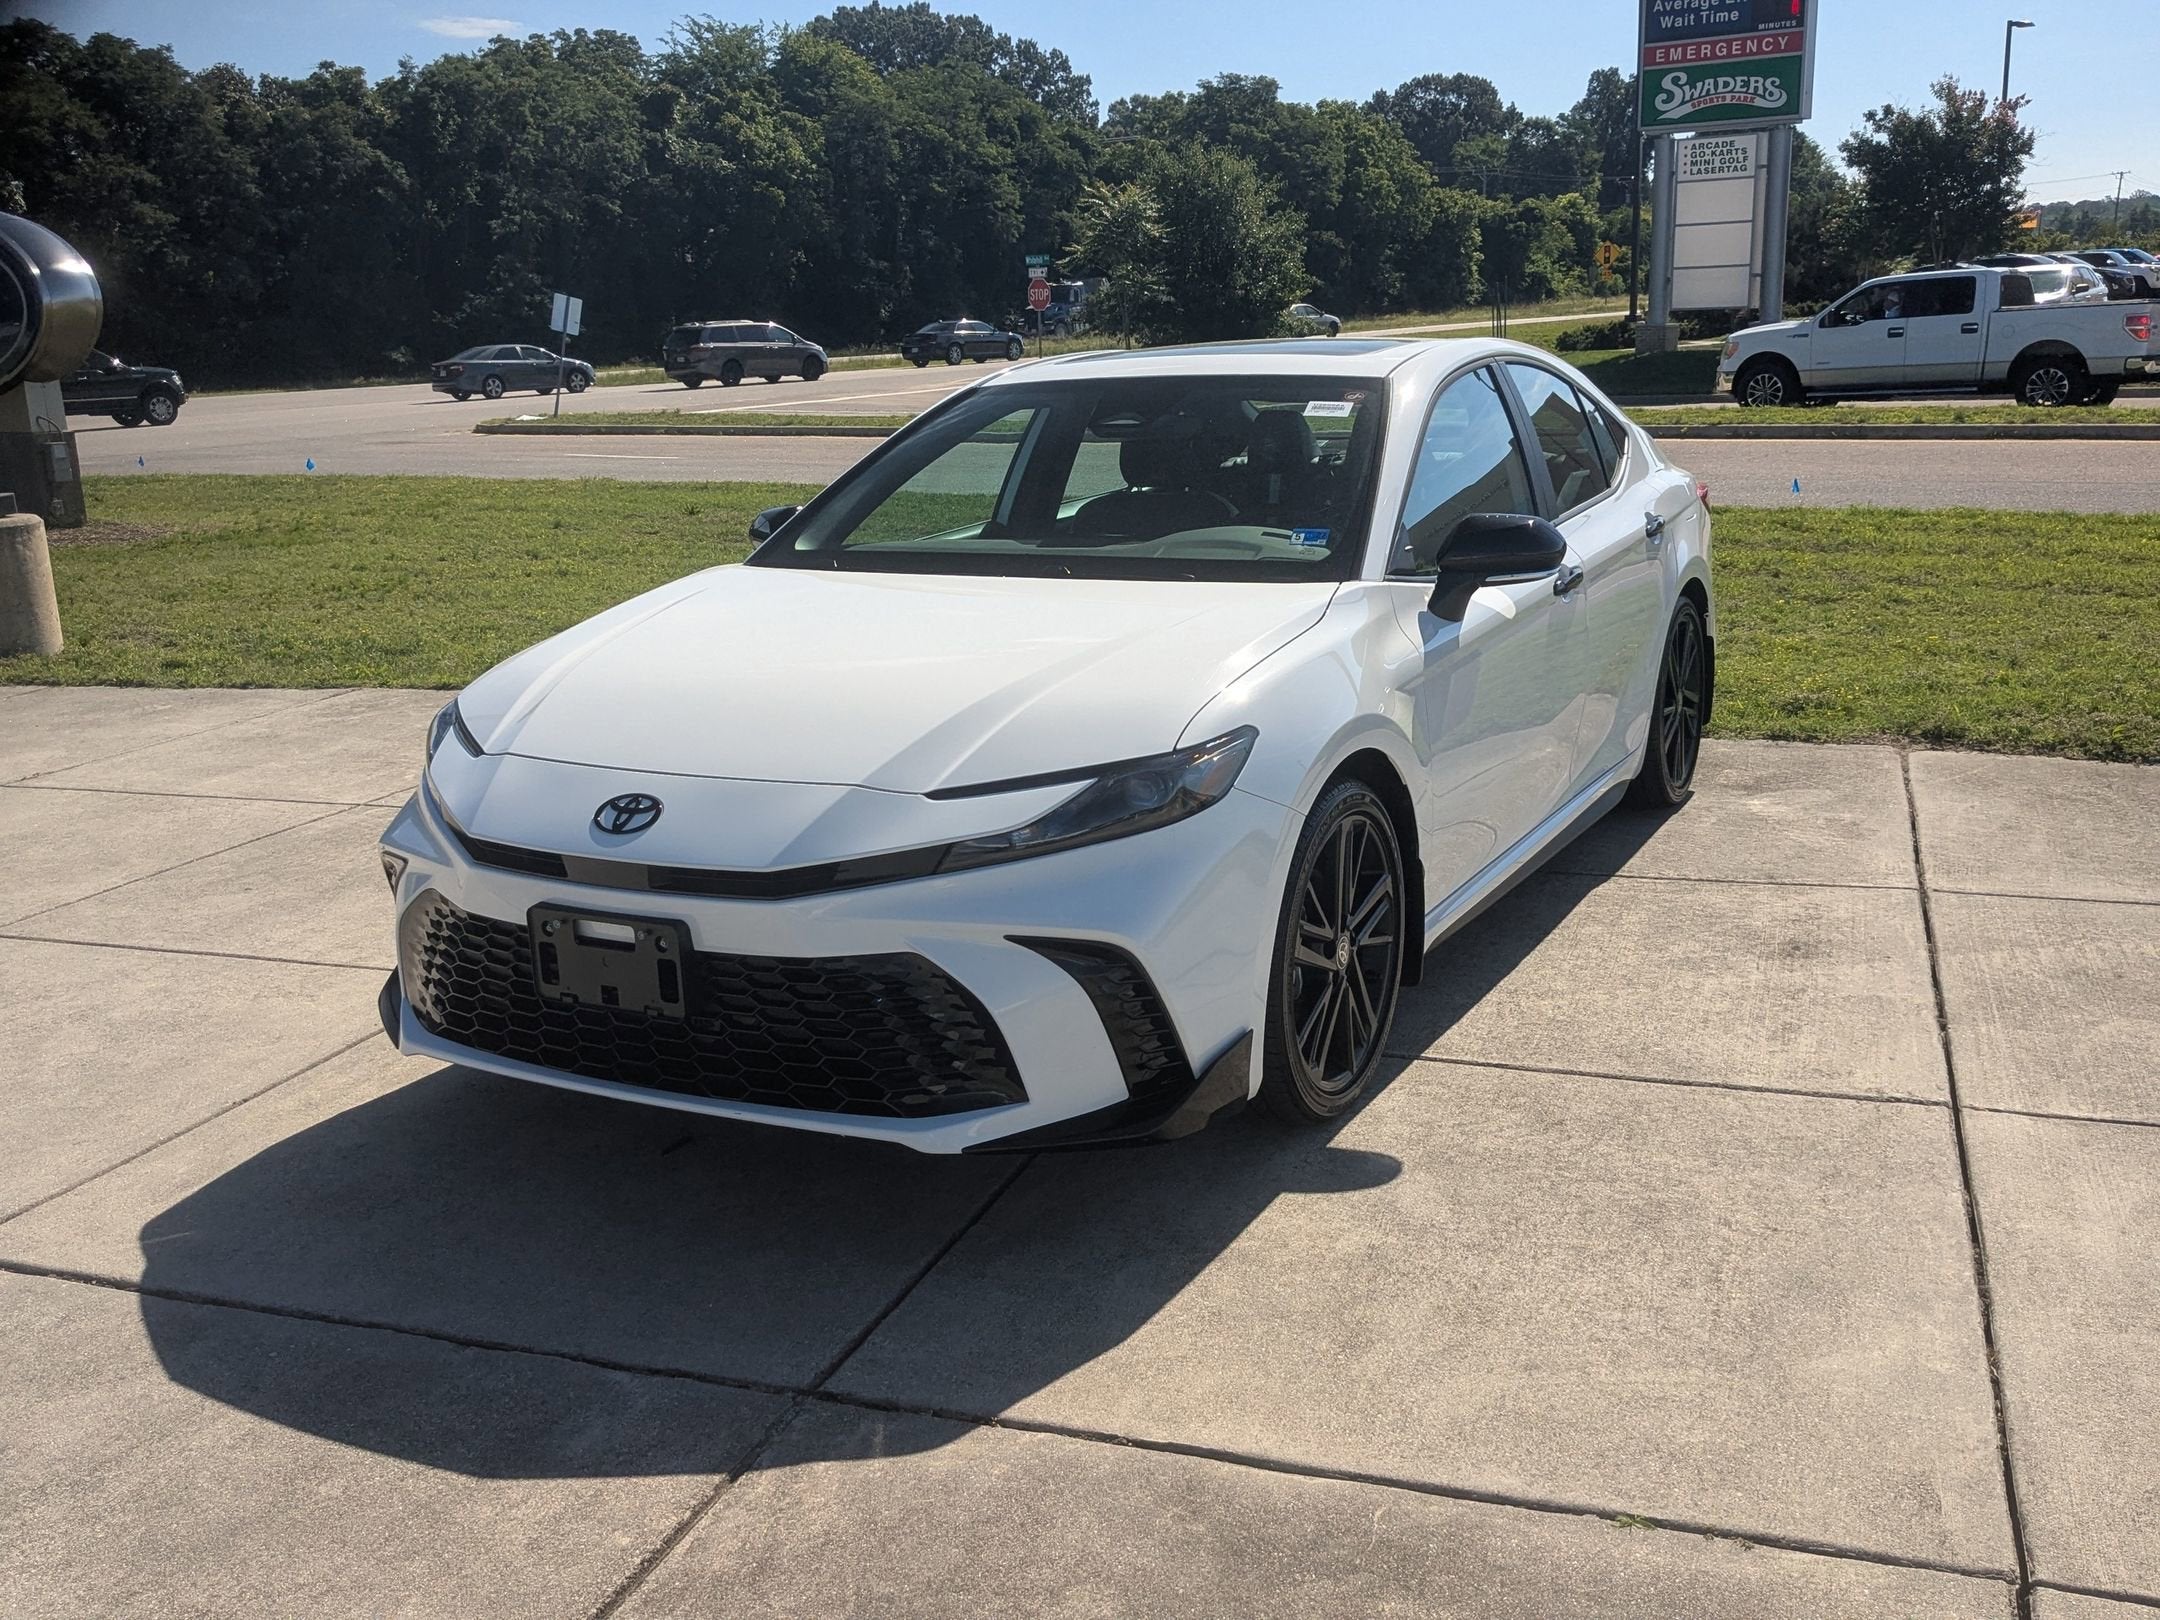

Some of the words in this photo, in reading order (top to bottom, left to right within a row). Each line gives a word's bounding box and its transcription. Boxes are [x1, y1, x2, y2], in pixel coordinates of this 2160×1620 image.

[1660, 14, 1695, 29] Wait
[1700, 10, 1740, 24] Time
[1758, 20, 1797, 30] MINUTES
[1655, 36, 1789, 62] EMERGENCY
[1690, 94, 1727, 110] SPORTS
[1729, 94, 1756, 104] PARK
[1690, 140, 1736, 151] ARCADE
[1690, 147, 1748, 159] GO-KARTS
[1690, 158, 1715, 167] MINI
[1719, 155, 1749, 165] GOLF
[1690, 164, 1748, 176] LASERTAG
[1030, 288, 1049, 301] STOP
